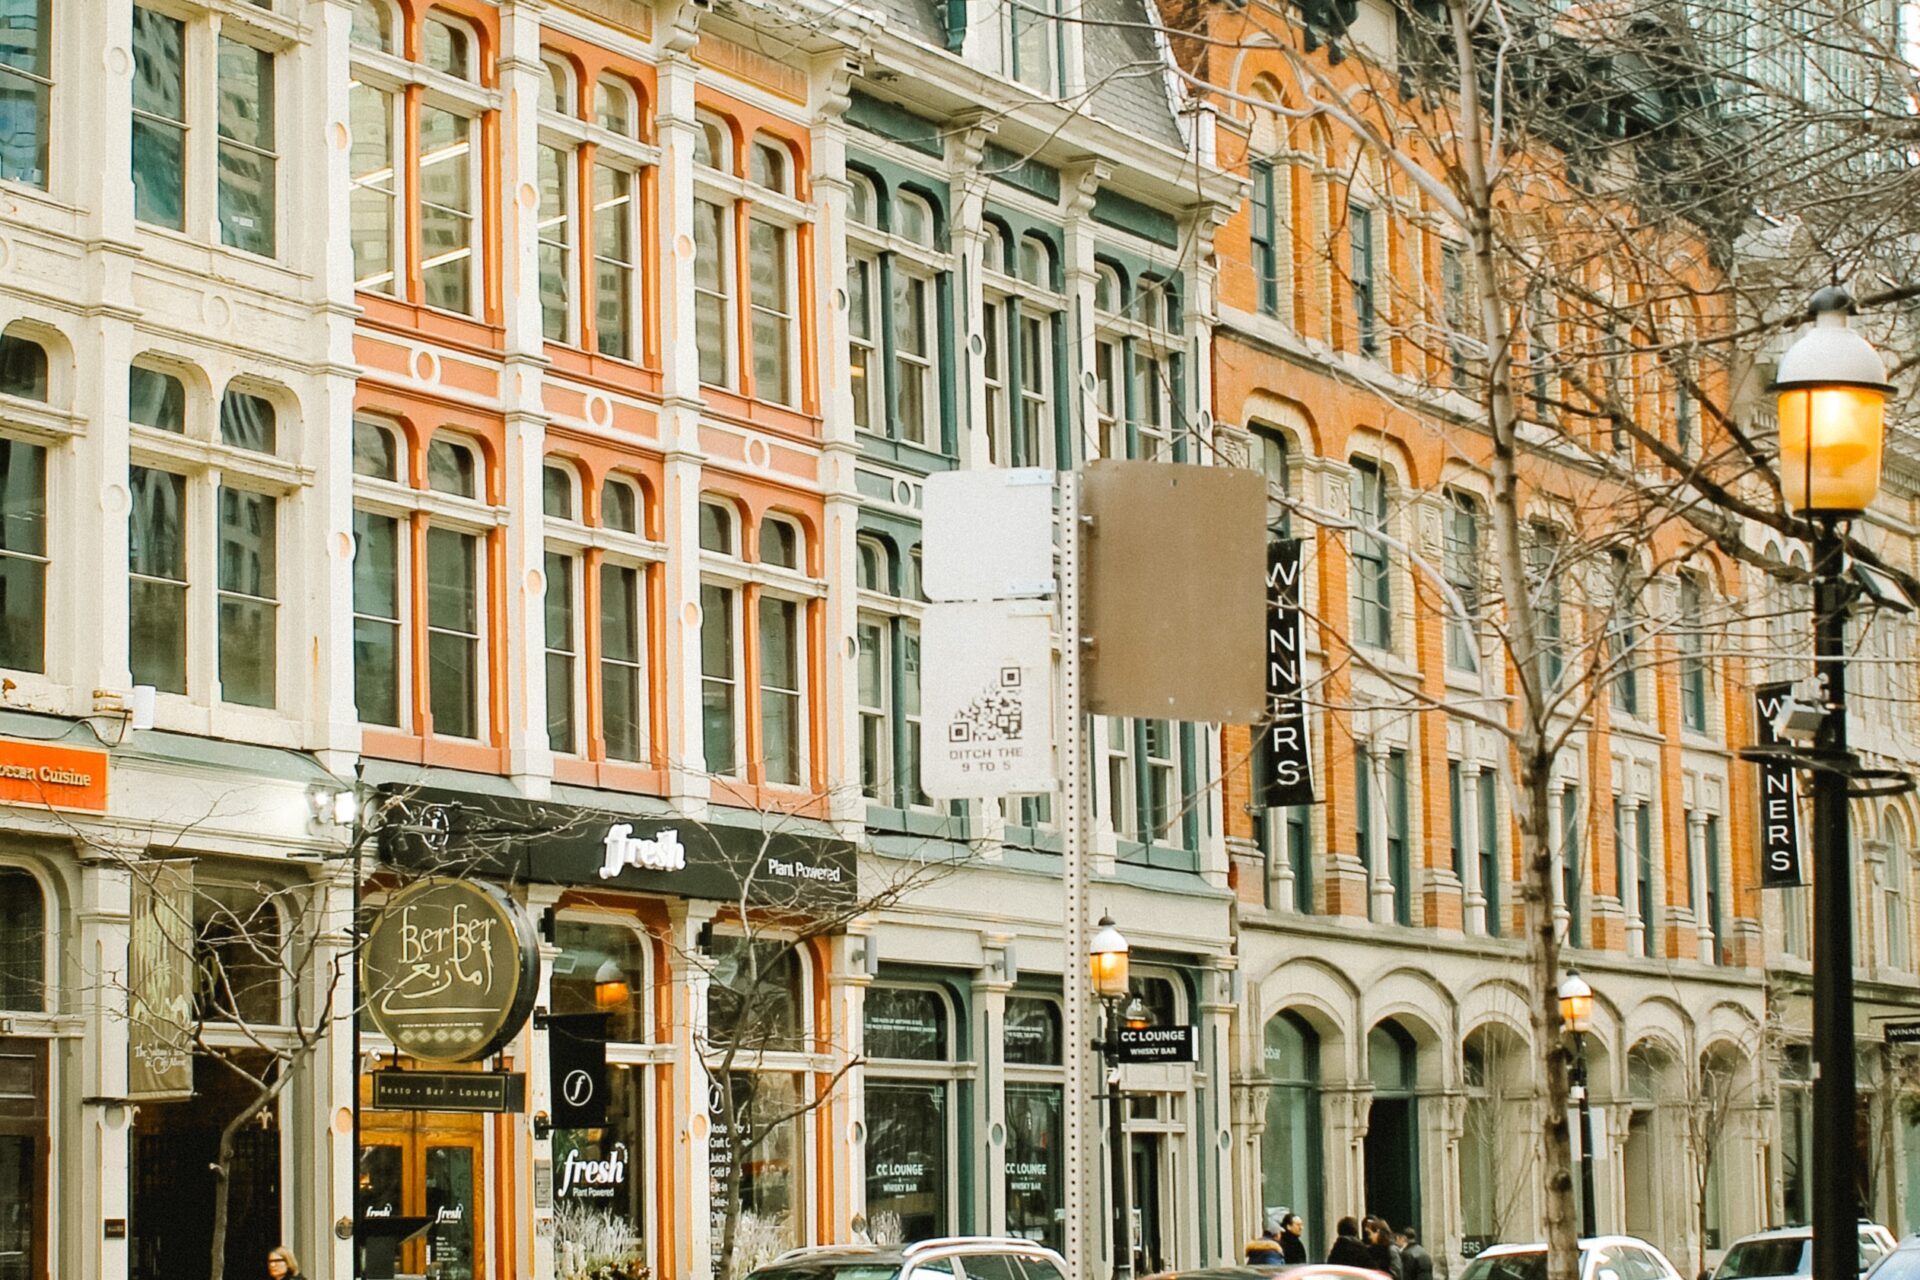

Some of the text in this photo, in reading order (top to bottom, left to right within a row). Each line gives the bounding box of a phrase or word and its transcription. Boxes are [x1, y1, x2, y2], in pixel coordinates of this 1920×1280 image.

[1265, 560, 1301, 786] WINNERS
[949, 746, 1023, 760] DITCH THE
[962, 762, 970, 772] 9
[979, 762, 995, 772] TO
[39, 766, 92, 787] Cuisine
[1758, 697, 1791, 872] WINERS
[599, 823, 687, 879] fresh
[768, 858, 841, 882] Plant Powered
[1121, 1030, 1186, 1042] CC LOUNGE
[1130, 1047, 1177, 1056] WHISKY BAR
[380, 1085, 501, 1099] Resto Bar Lounge
[558, 1148, 625, 1197] fresh
[876, 1163, 924, 1176] CC LOUNGE
[1005, 1162, 1047, 1175] CC LOUNGE
[572, 1187, 615, 1197] Plant Powered
[883, 1182, 917, 1192] WHISKY BAR
[1011, 1181, 1042, 1191] WHISKY BAR
[435, 1205, 462, 1224] fresh
